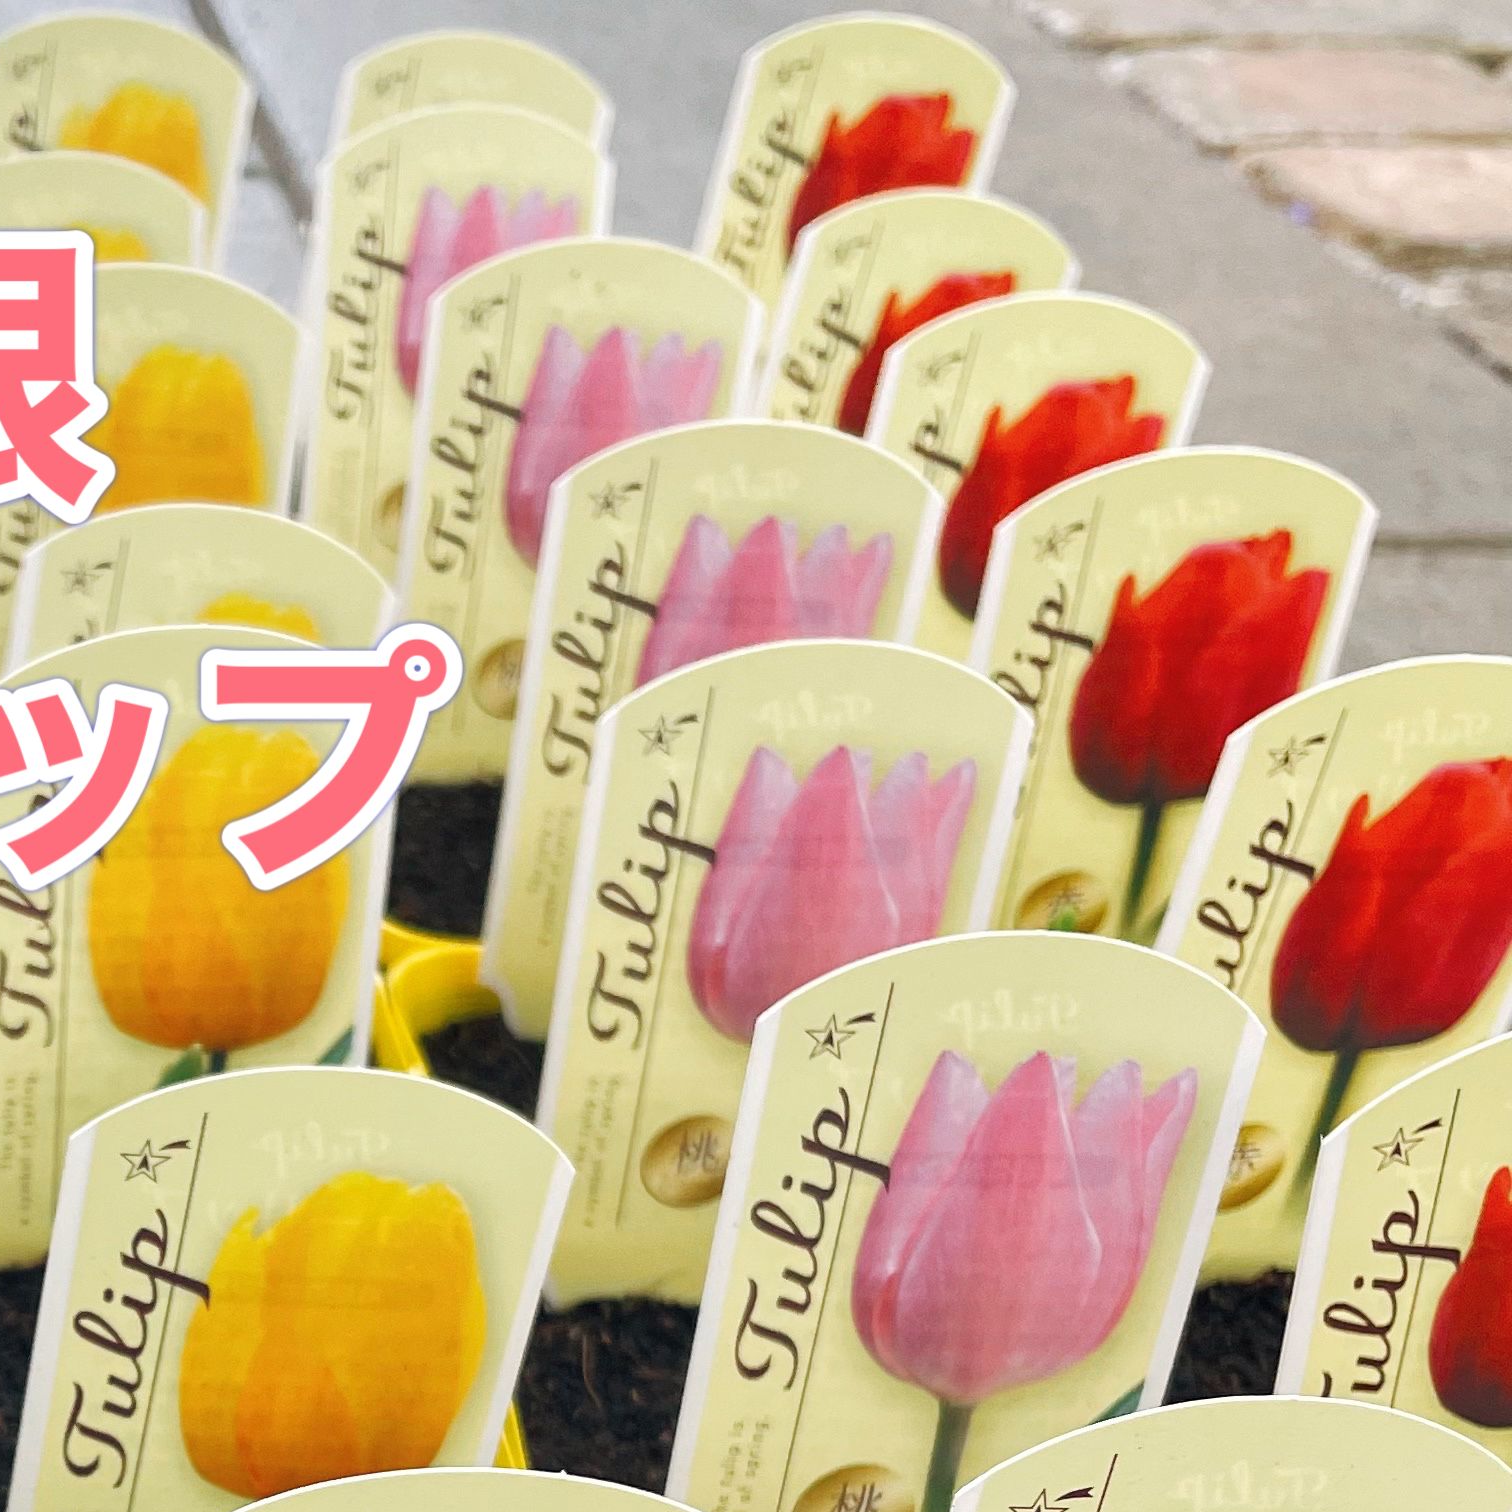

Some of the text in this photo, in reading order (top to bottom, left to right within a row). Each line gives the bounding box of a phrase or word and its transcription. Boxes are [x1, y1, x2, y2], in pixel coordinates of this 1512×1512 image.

[328, 211, 409, 423] Tulip
[425, 346, 525, 573] Tulip
[543, 540, 660, 786] Tulip
[588, 778, 717, 1051] Tulip
[1197, 799, 1318, 990] ulip
[62, 1208, 211, 1489] Tulip
[734, 1086, 891, 1391] Tulip
[1321, 1190, 1461, 1398] ulip
